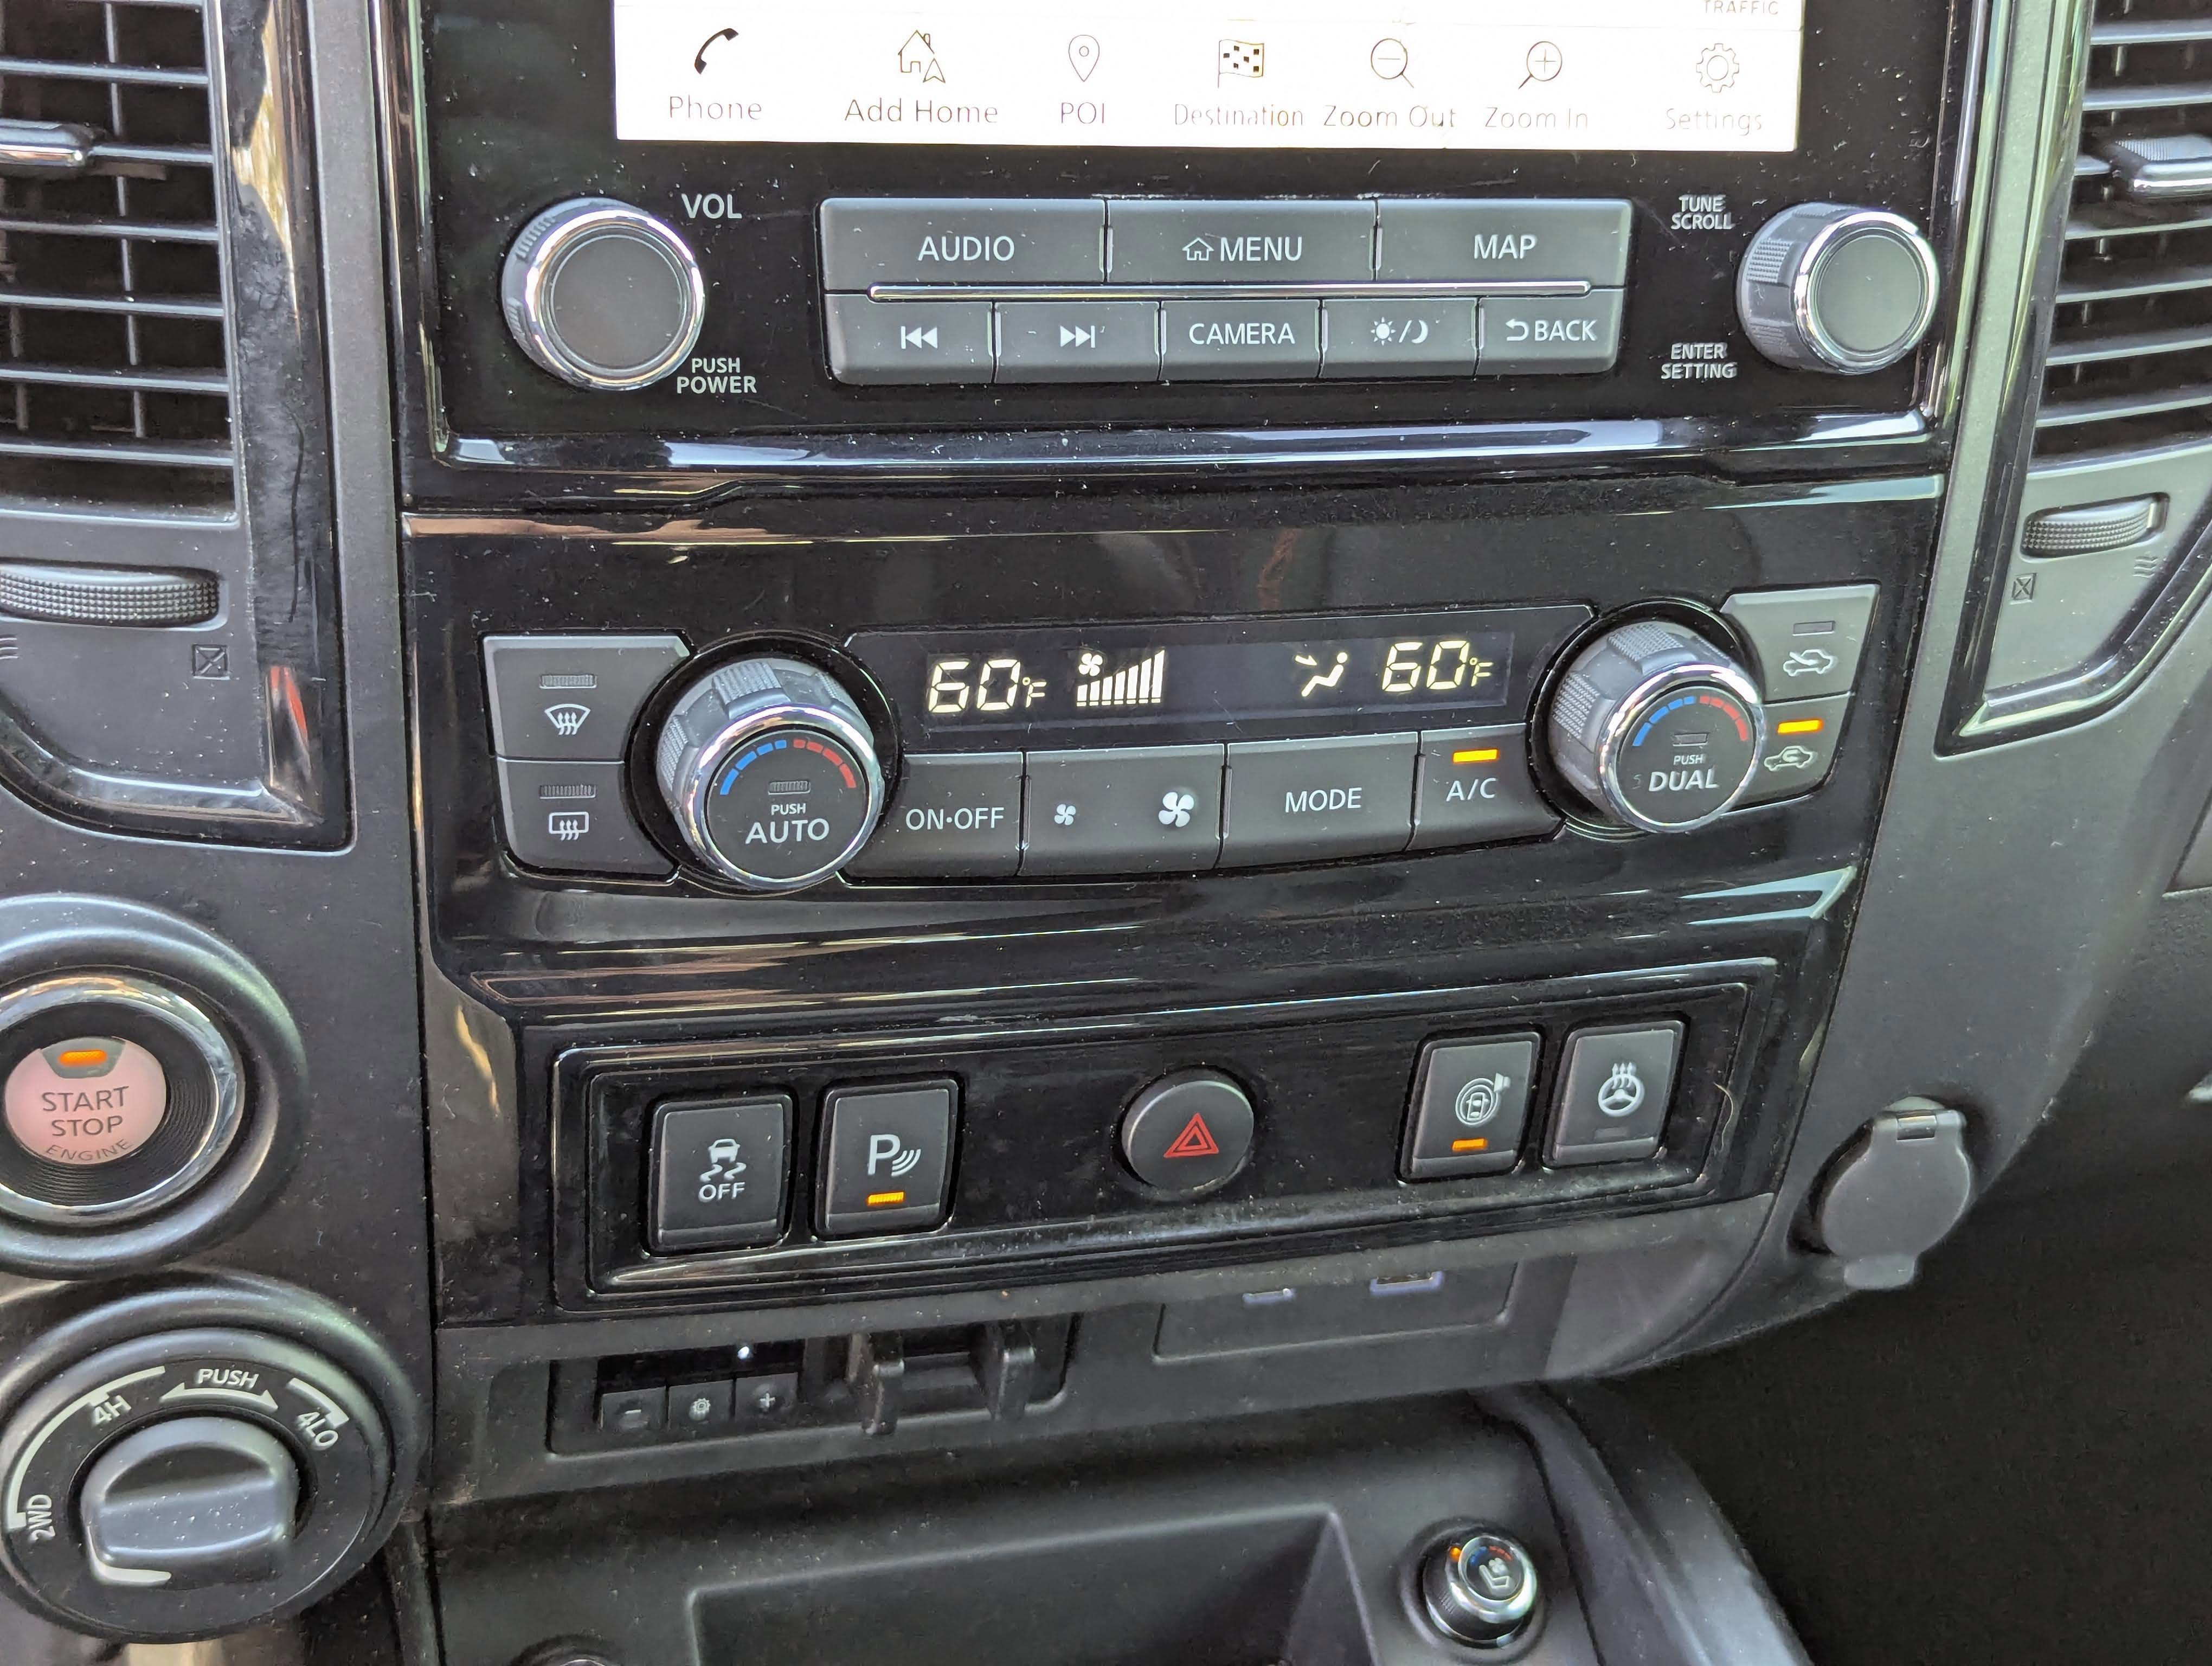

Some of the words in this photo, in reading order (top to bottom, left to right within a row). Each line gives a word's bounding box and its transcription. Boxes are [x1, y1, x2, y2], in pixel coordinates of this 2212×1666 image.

[1703, 0, 1779, 15] TRAFFIC
[669, 95, 762, 121] Phone
[845, 99, 902, 123] Add
[916, 100, 999, 124] Home
[1060, 102, 1105, 124] POI
[1174, 104, 1304, 127] Destination
[1323, 105, 1398, 128] Zoom
[1409, 105, 1456, 129] Out
[1484, 106, 1559, 129] Zoom
[1568, 108, 1589, 130] In
[1666, 107, 1763, 137] Settings
[682, 194, 742, 219] VOL
[1679, 195, 1724, 212] TUNE
[1671, 213, 1732, 230] SCROLL
[917, 236, 1015, 261] AUDIO
[1219, 236, 1303, 261] MENU
[1473, 234, 1536, 259] MAP
[1189, 323, 1296, 344] CAMERA
[1534, 320, 1597, 341] BACK
[1671, 342, 1727, 361] ENTER
[691, 357, 741, 374] PUSH
[1660, 362, 1737, 379] SETTING
[677, 375, 757, 394] POWER
[1673, 754, 1705, 766] PUSH
[1445, 777, 1497, 802] A/C
[1648, 768, 1719, 792] DUAL
[771, 803, 807, 816] PUSH
[1284, 787, 1362, 813] MODE
[745, 818, 829, 844] AUTO
[41, 1086, 130, 1112] START
[51, 1115, 124, 1137] STOP
[46, 1139, 134, 1162] ENGINE
[867, 1135, 901, 1176] P
[698, 1182, 745, 1202] OFF
[197, 1368, 260, 1388] PUSH
[91, 1394, 132, 1425] 4H
[297, 1410, 339, 1449] 4LO
[25, 1494, 56, 1542] 2WD
